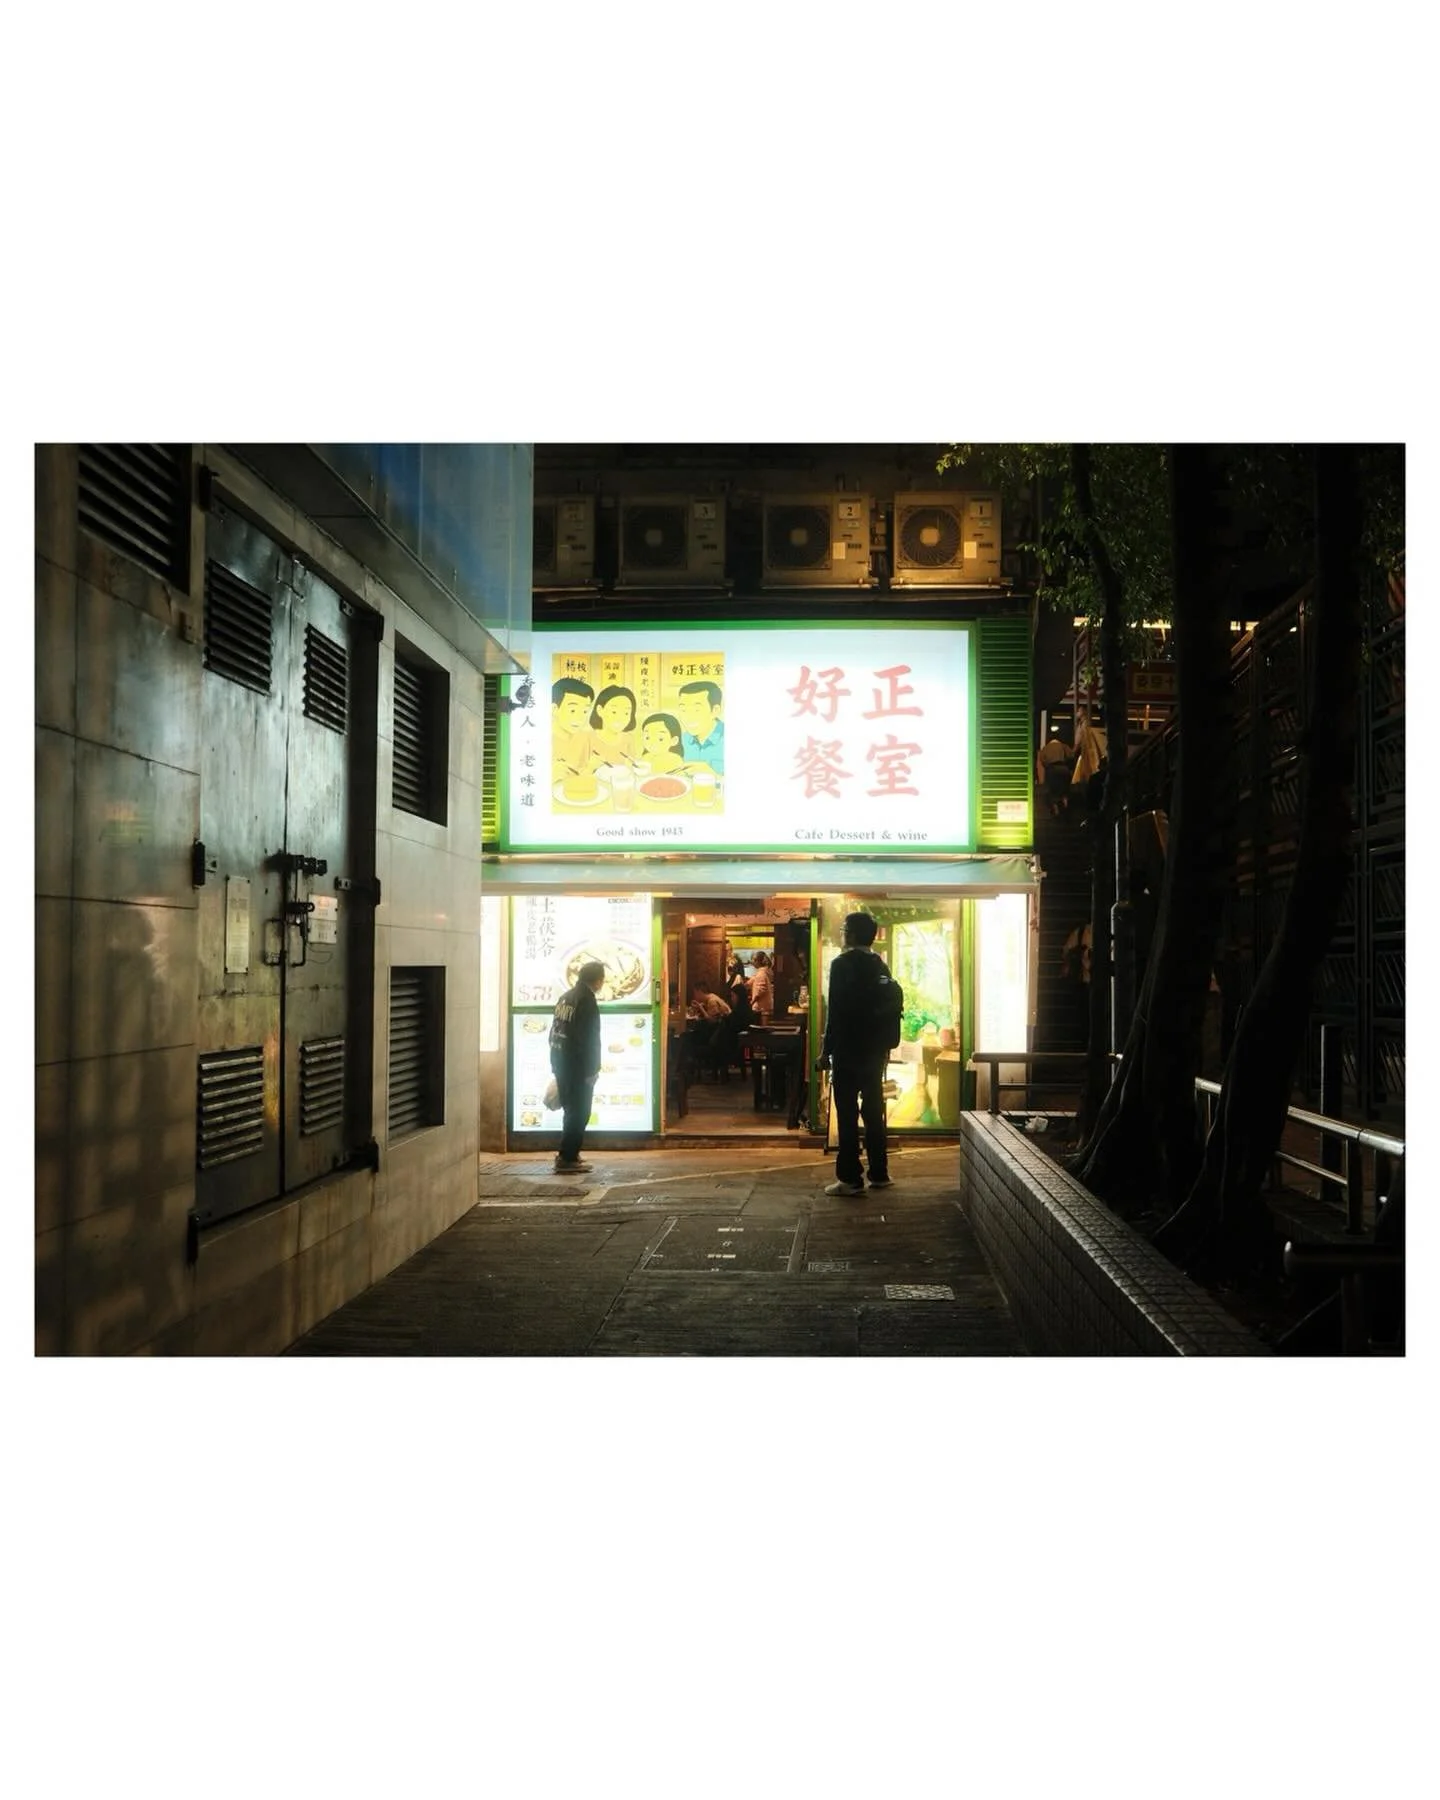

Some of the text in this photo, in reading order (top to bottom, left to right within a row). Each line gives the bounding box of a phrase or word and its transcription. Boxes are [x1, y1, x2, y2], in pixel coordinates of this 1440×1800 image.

[786, 664, 925, 723] 好正
[789, 733, 924, 800] 餐室
[596, 826, 624, 837] Good
[629, 826, 657, 837] show
[794, 828, 929, 841] Cafe Dessert & wine
